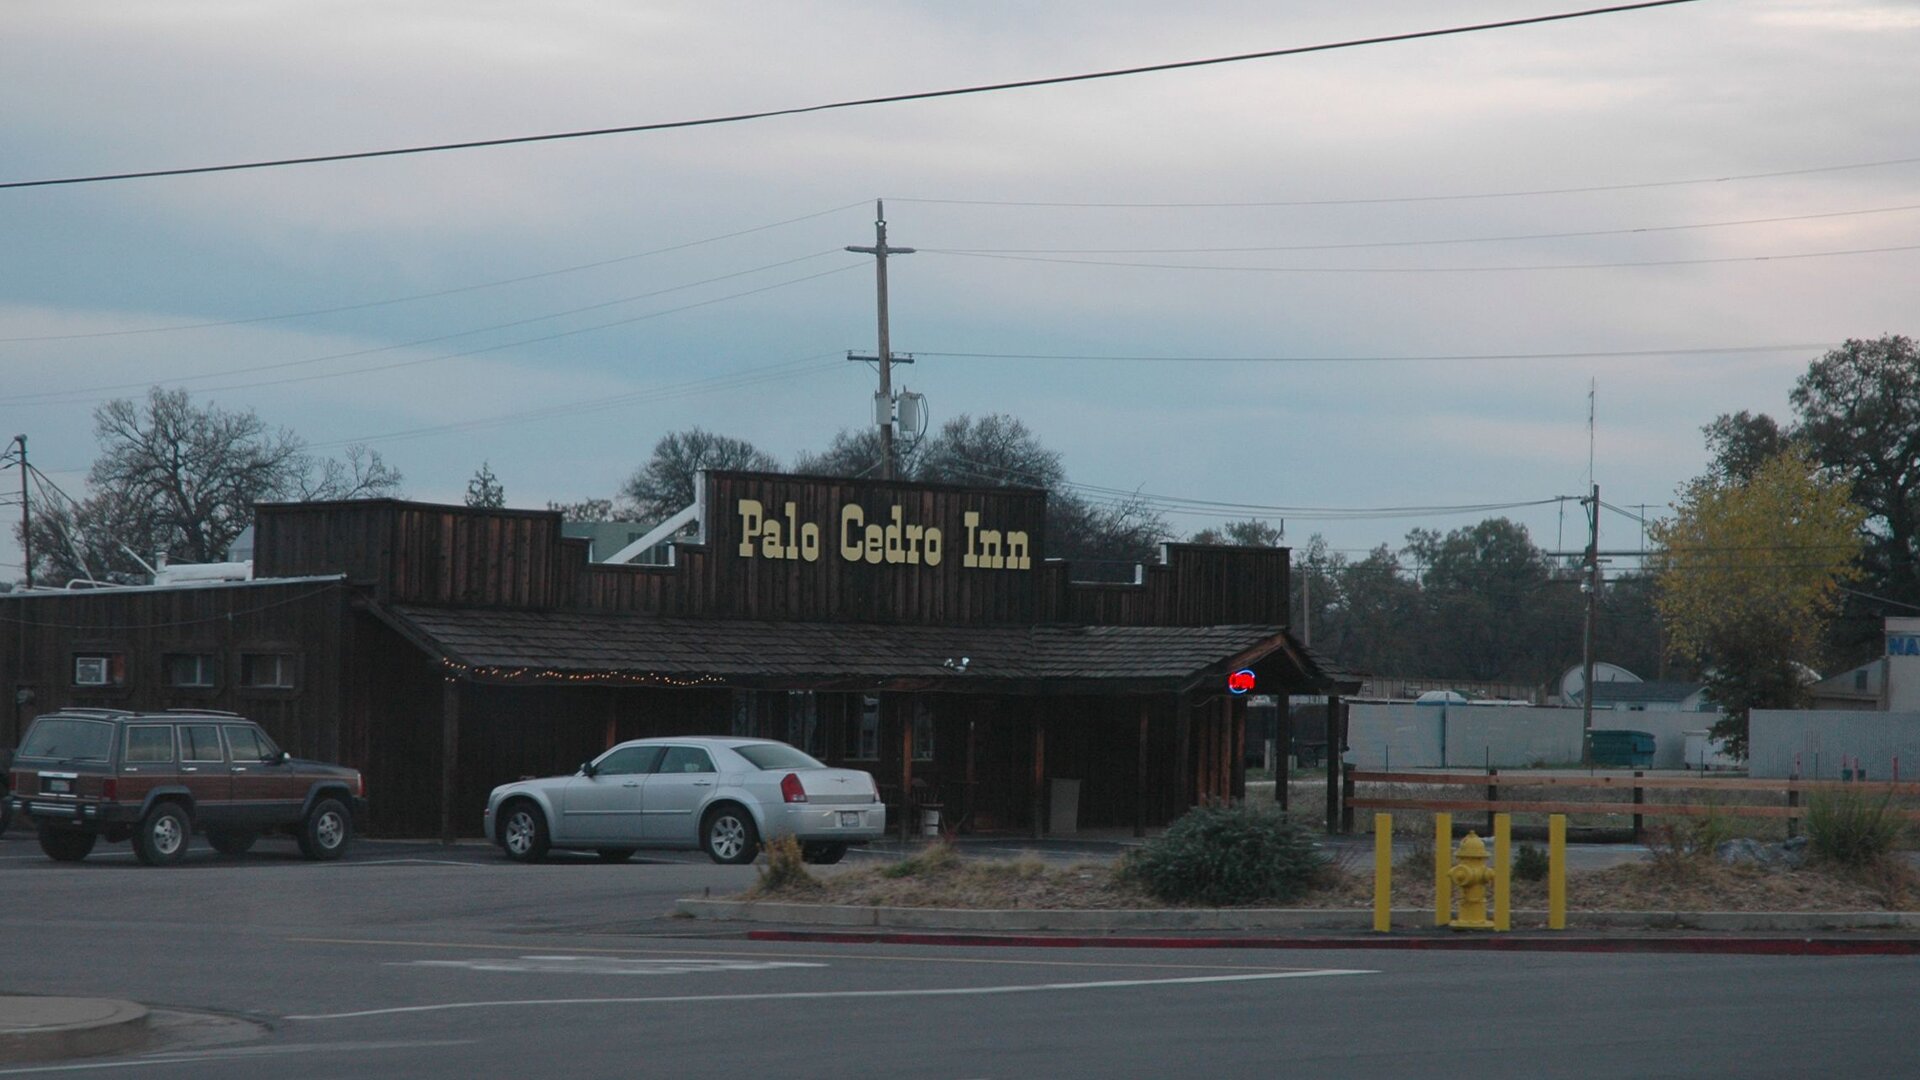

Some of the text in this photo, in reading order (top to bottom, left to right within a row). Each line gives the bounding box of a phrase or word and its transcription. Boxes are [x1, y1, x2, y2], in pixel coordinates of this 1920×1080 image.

[738, 499, 1031, 570] Palo Cedro Inn
